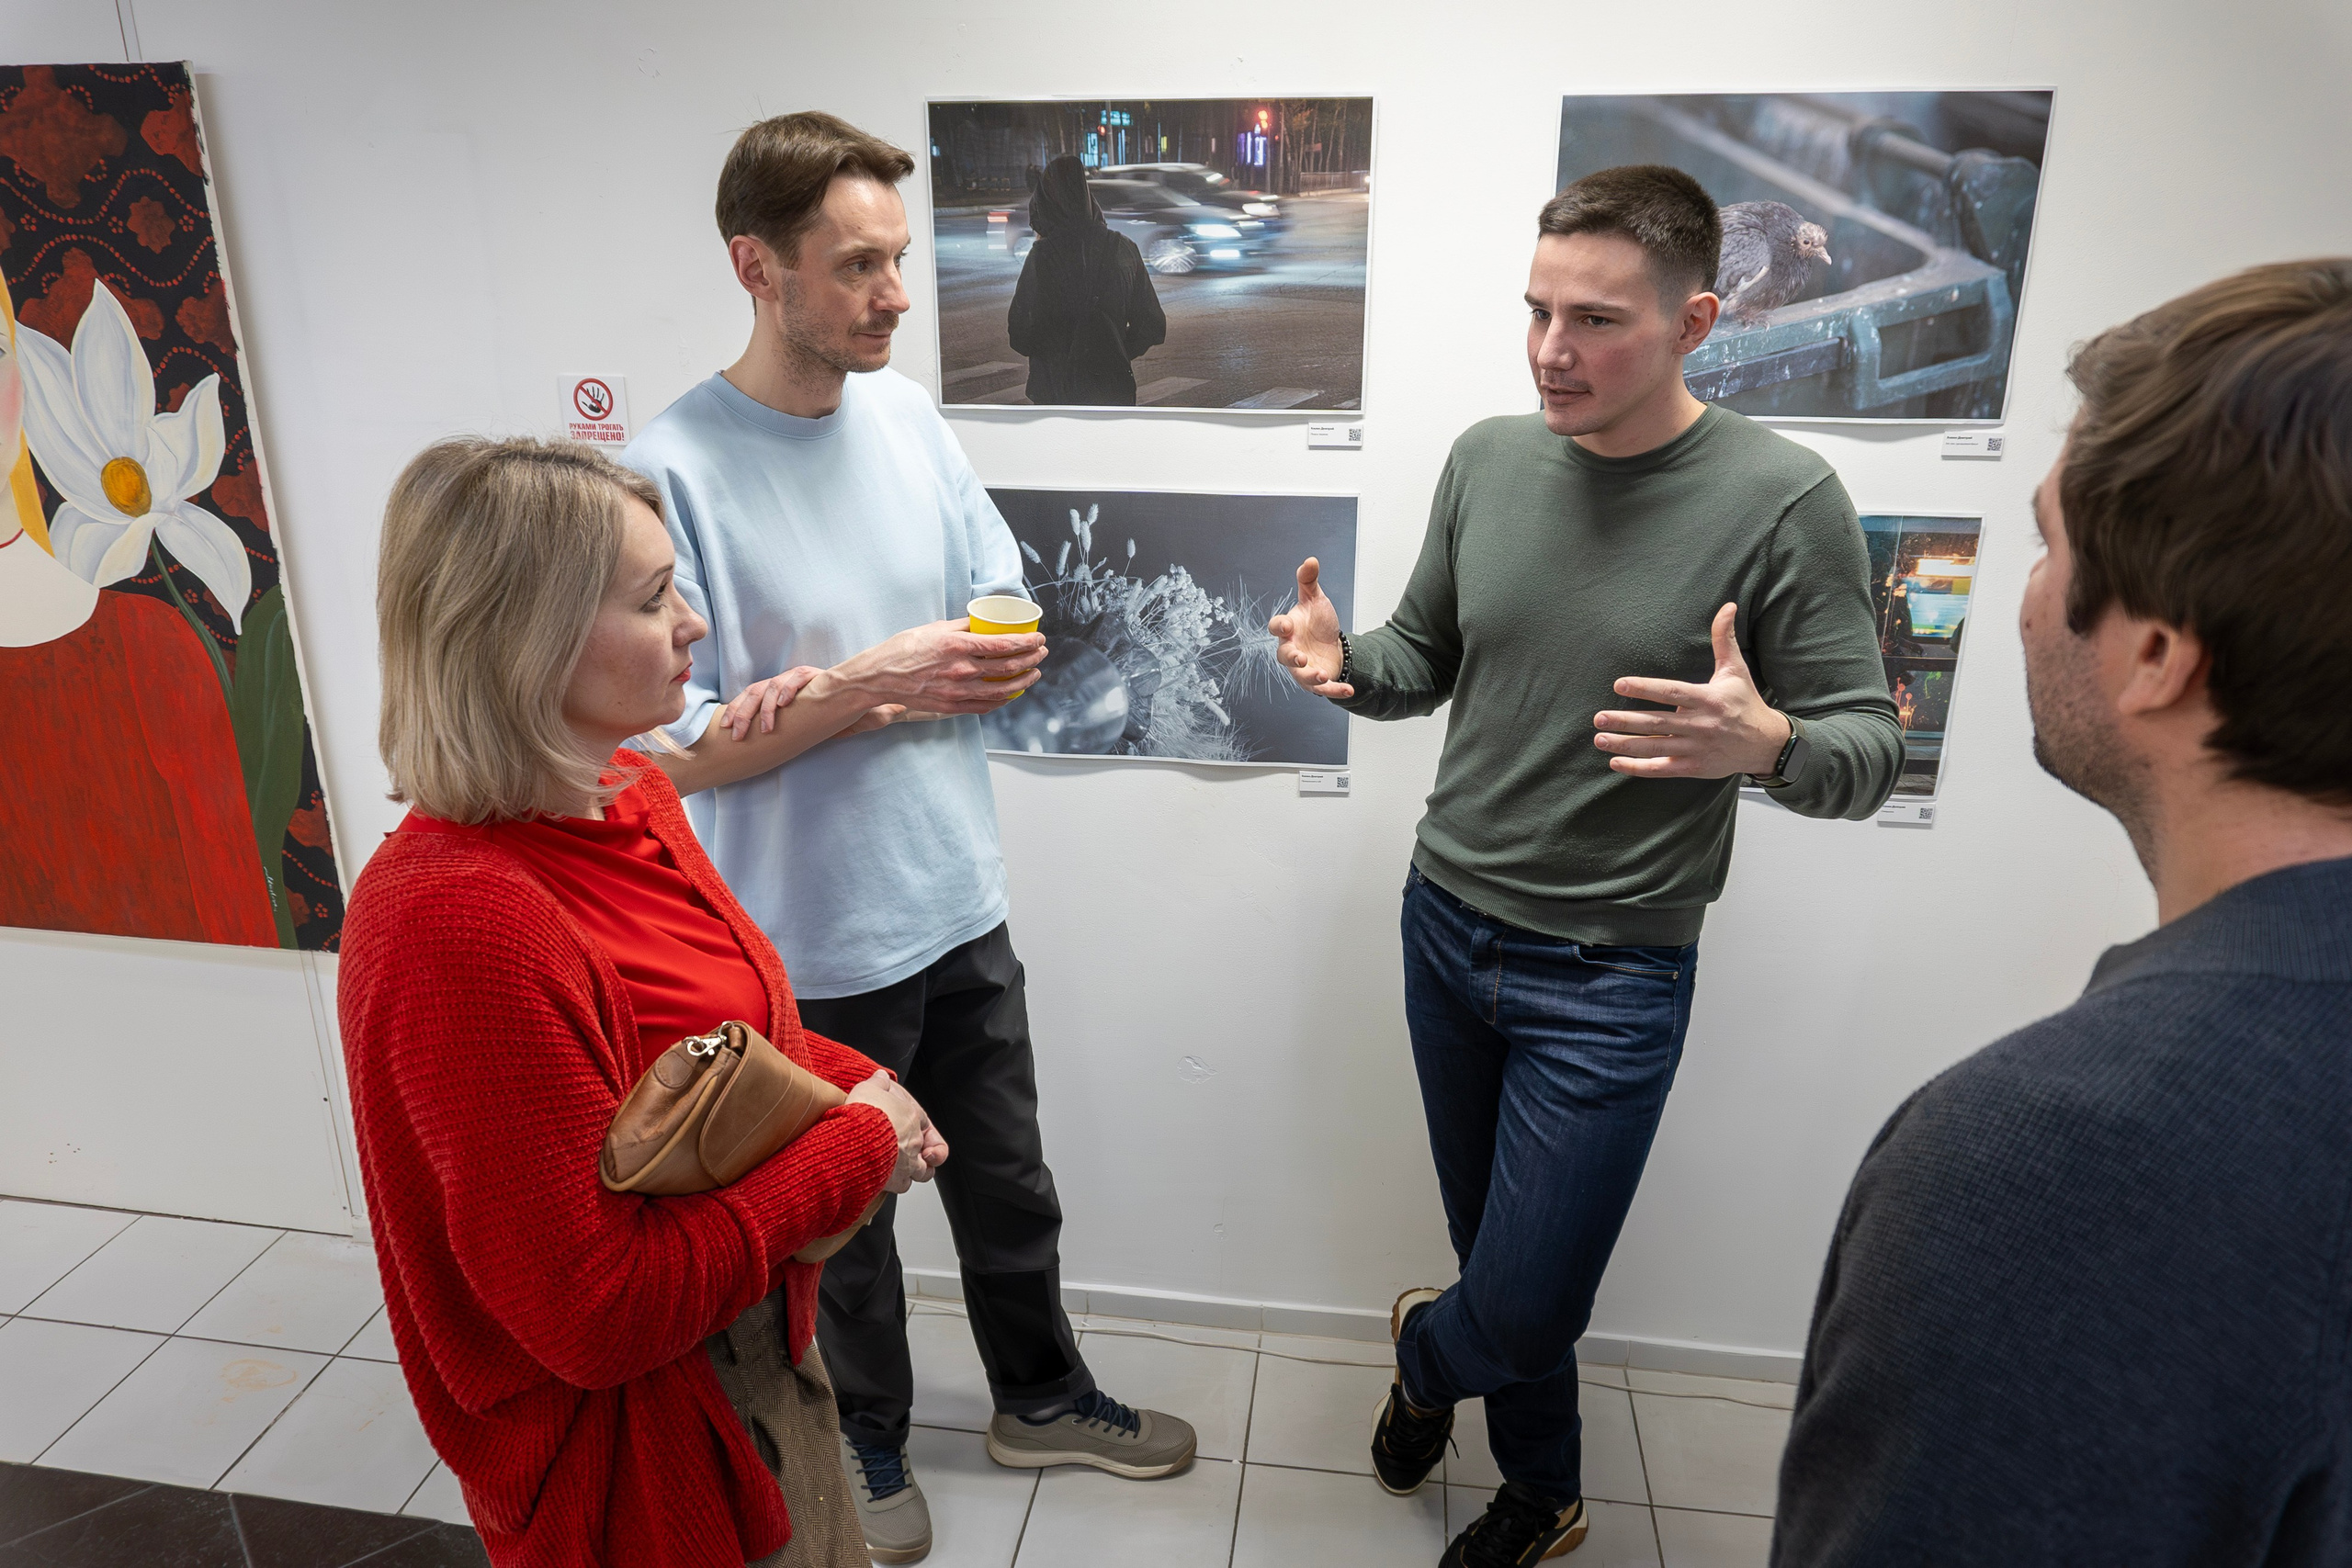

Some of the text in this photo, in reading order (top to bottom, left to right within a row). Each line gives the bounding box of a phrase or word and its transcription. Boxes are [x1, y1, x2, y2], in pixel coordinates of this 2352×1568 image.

[569, 423, 624, 432] РУКАМИ ТРОГАТЬ
[570, 431, 625, 442] ЗАПРЕЩЕНО!
